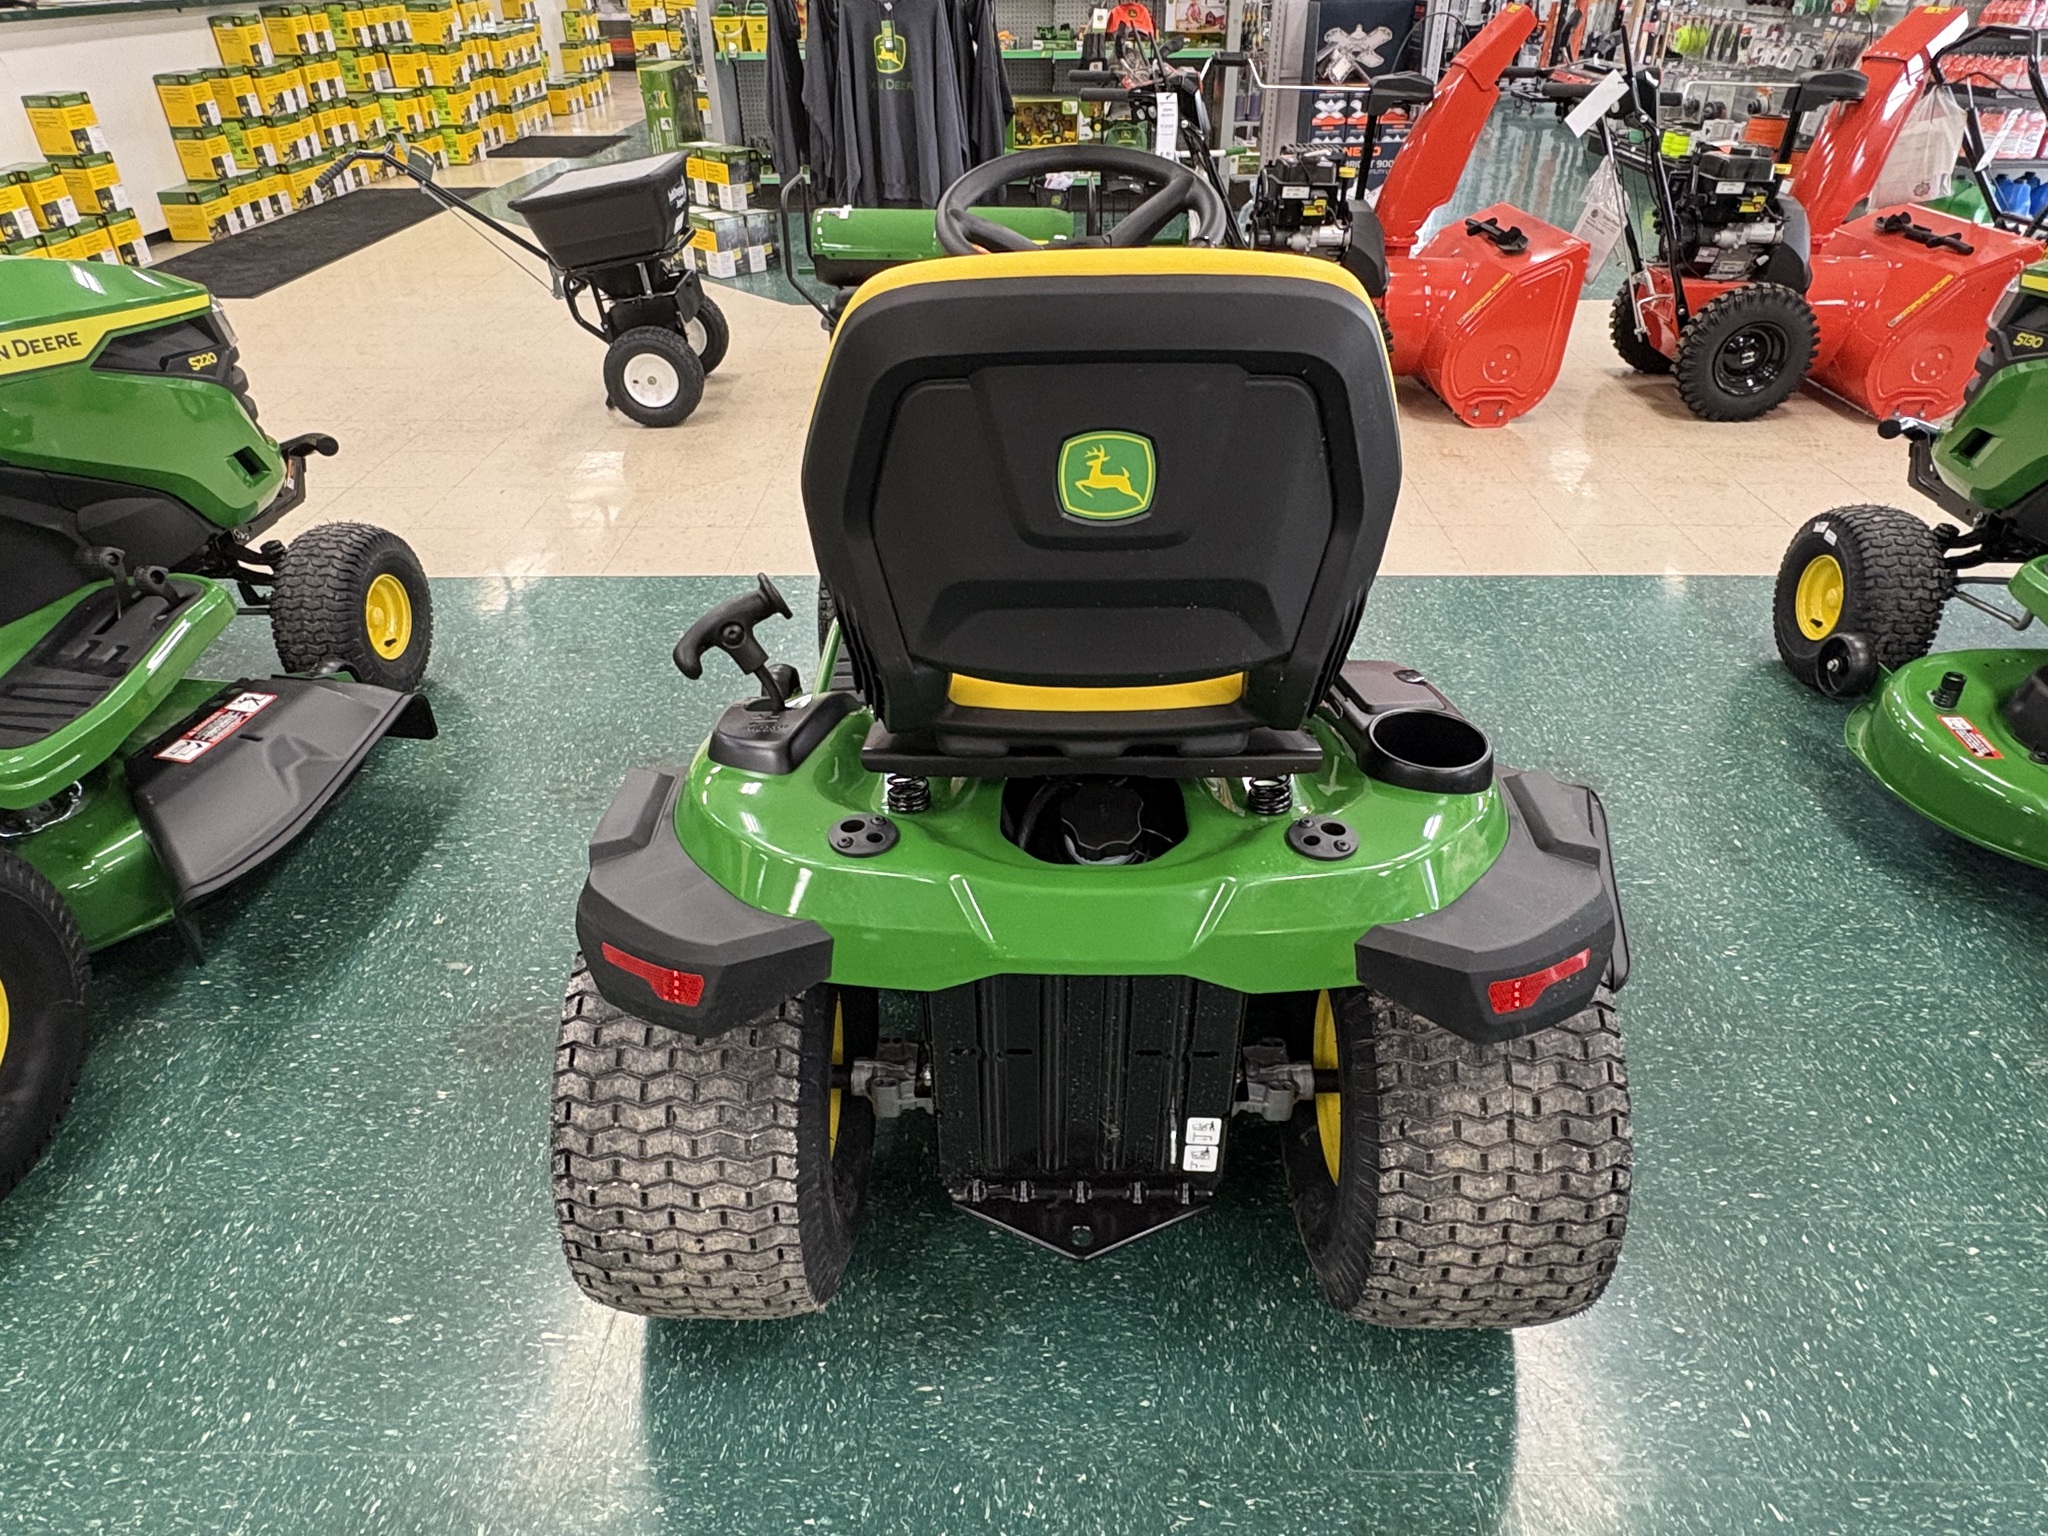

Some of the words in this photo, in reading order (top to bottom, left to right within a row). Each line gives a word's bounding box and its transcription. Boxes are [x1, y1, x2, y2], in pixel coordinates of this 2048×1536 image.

[1343, 146, 1382, 157] NEO
[11, 332, 82, 357] DEERE
[188, 352, 218, 371] S220
